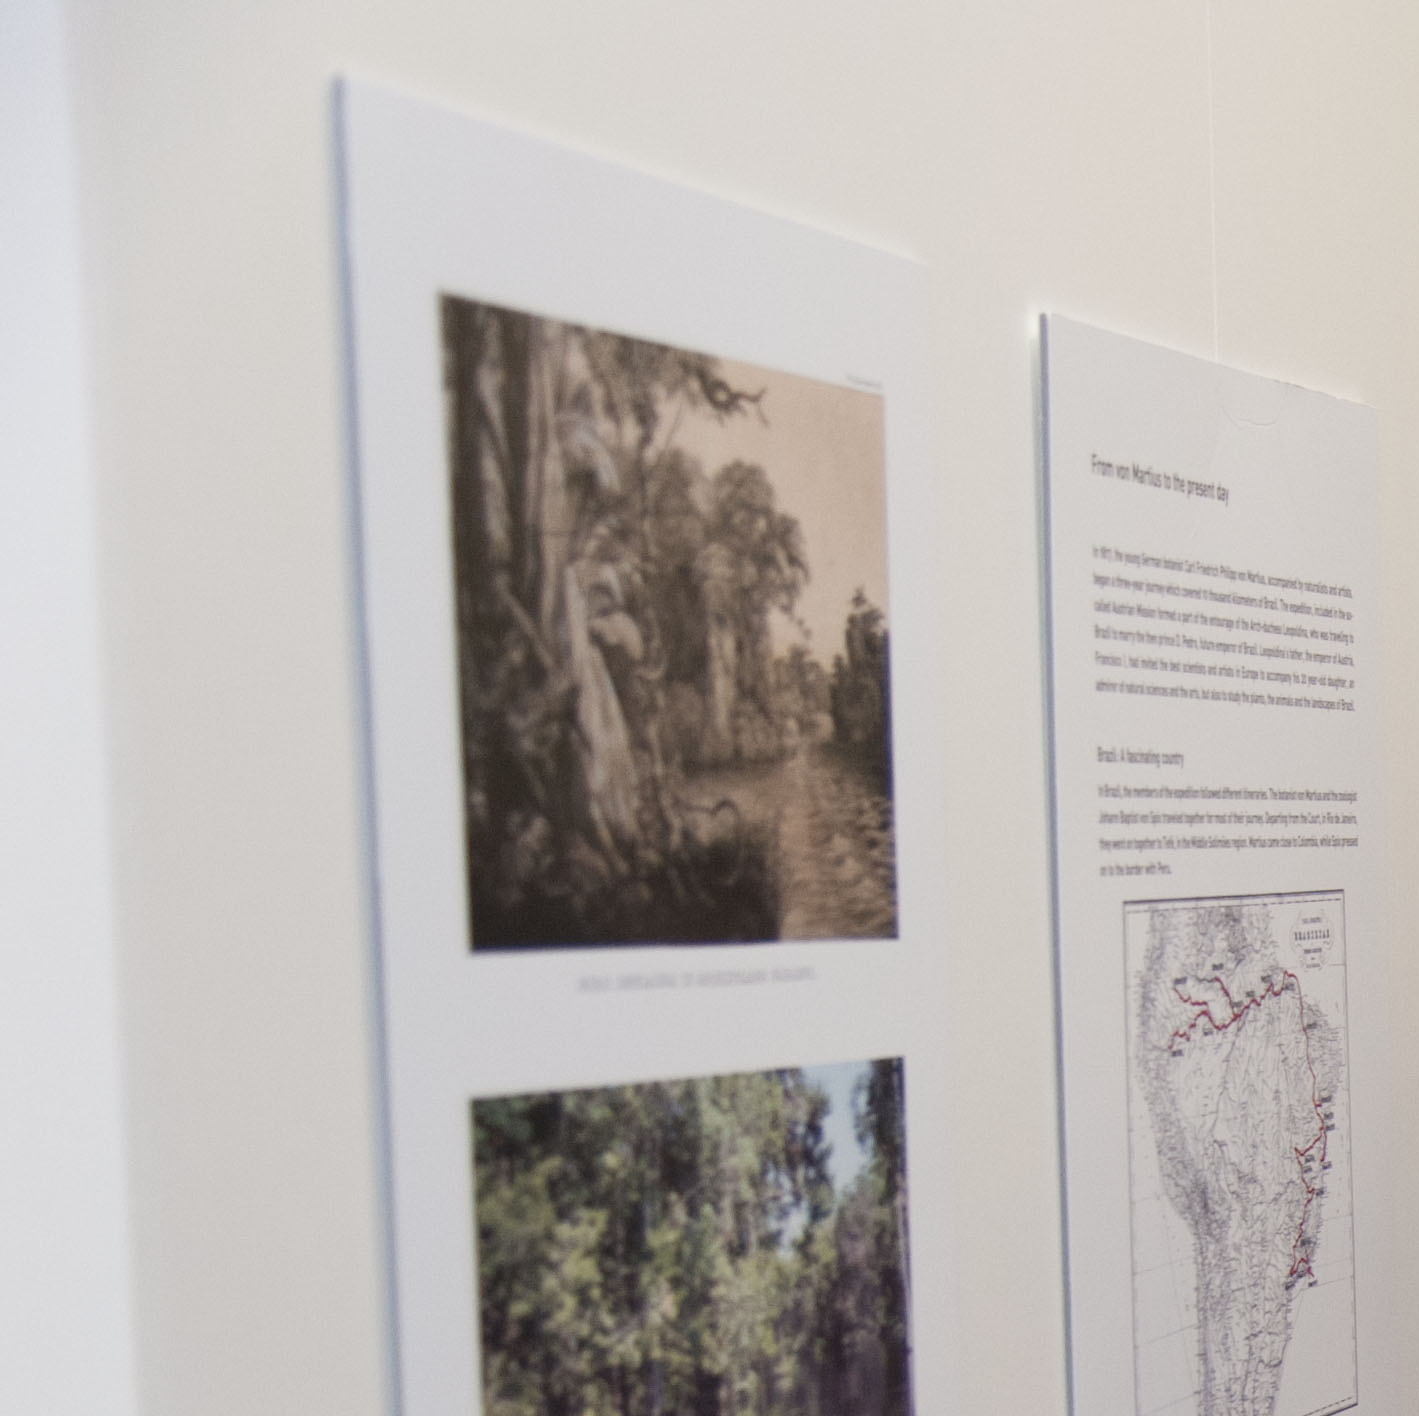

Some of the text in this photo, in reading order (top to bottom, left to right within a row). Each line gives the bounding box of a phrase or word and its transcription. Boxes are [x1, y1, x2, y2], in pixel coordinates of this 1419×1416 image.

[1091, 453, 1114, 478] From
[1132, 463, 1161, 488] Martius
[1187, 479, 1214, 499] present
